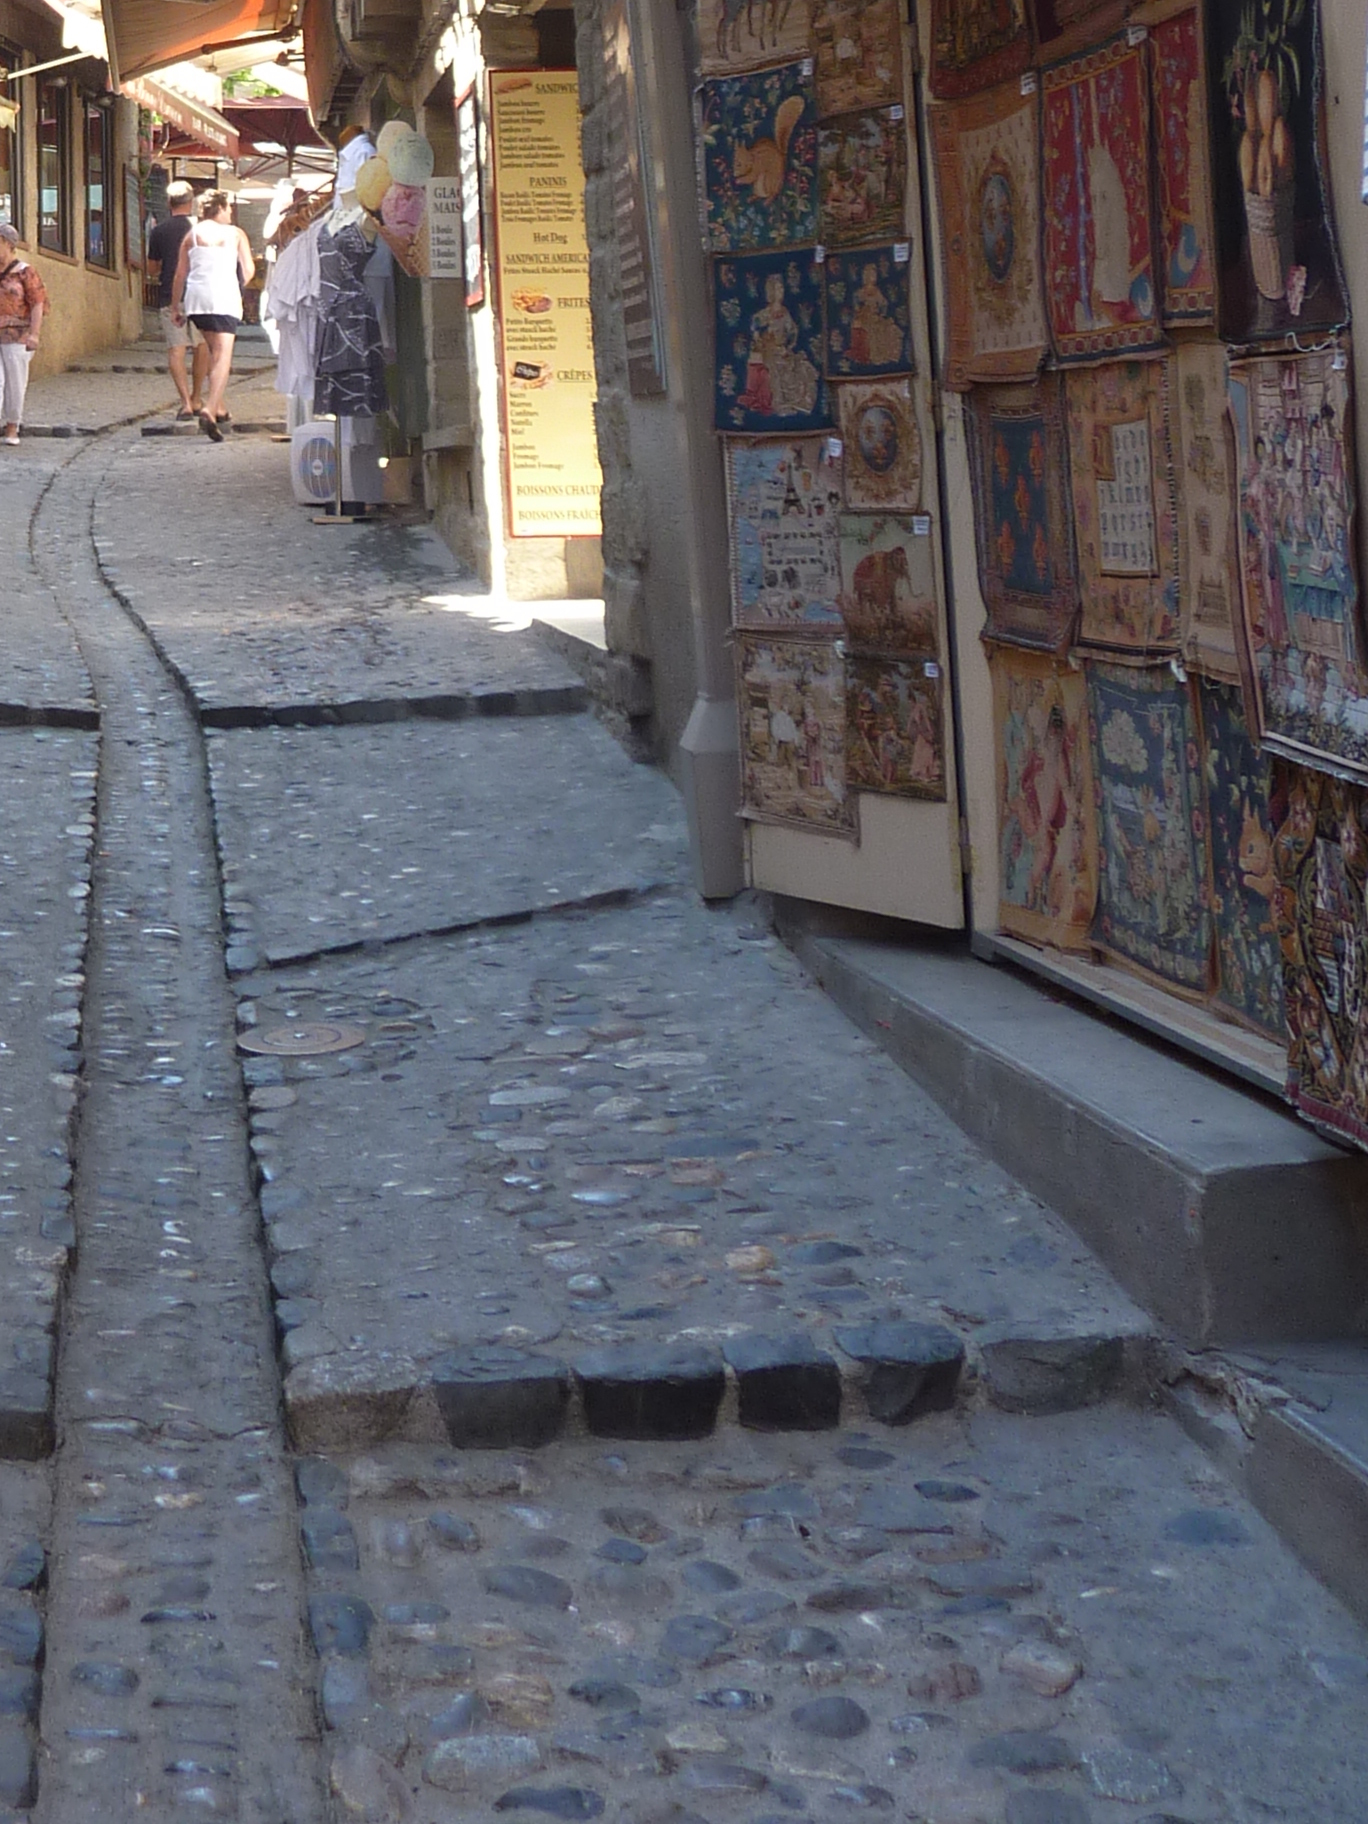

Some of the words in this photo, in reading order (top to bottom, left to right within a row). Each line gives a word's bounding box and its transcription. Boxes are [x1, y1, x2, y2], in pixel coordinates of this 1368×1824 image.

[529, 176, 568, 186] PANINIS
[533, 232, 549, 242] Hot
[550, 232, 568, 244] Dog
[506, 253, 550, 263] SANDWICH
[517, 485, 563, 495] BOISSONS
[519, 510, 565, 521] BOISSONS
